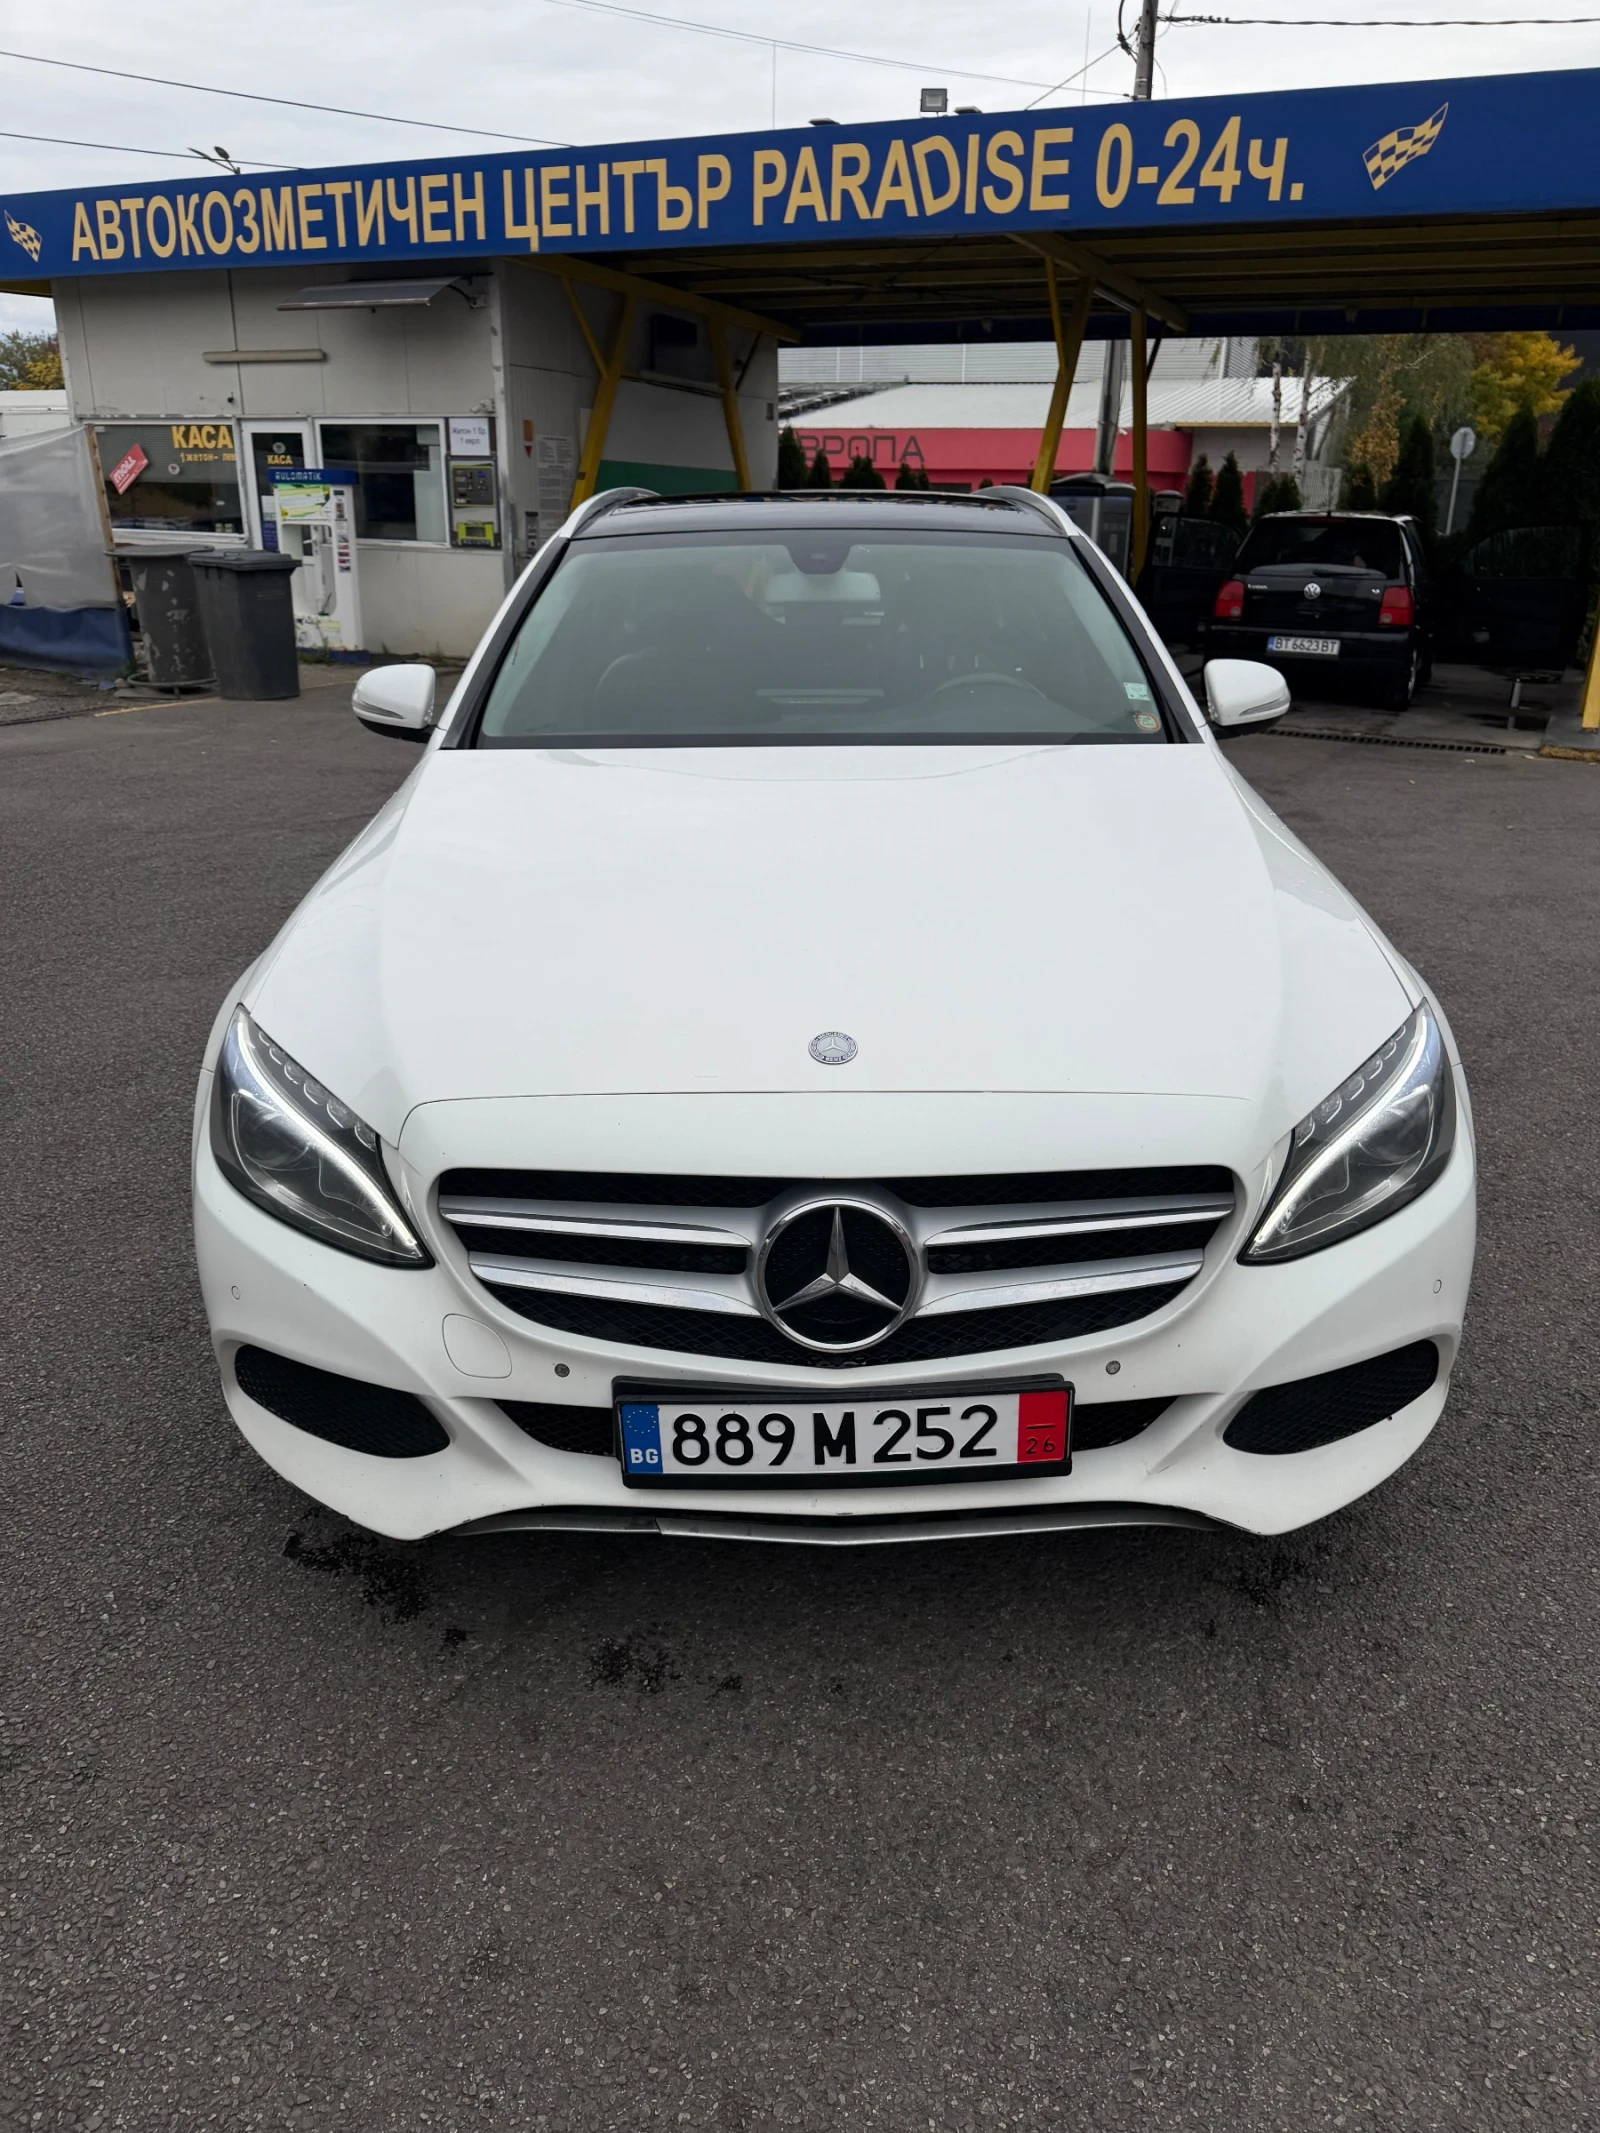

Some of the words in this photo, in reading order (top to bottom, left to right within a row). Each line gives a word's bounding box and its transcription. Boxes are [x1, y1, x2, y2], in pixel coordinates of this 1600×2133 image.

[71, 171, 487, 262] АВТОКОЗМЕТИЧЕН
[503, 154, 732, 252] ЦЕНТЪР
[752, 127, 1074, 226] PARADISE
[1096, 115, 1305, 209] 0-24ч.
[171, 425, 233, 449] КАСА
[267, 455, 293, 465] КАСА
[672, 1412, 796, 1467] 889
[813, 1411, 857, 1465] M
[872, 1404, 998, 1462] 252
[1025, 1436, 1057, 1456] 26
[630, 1448, 659, 1465] BG
